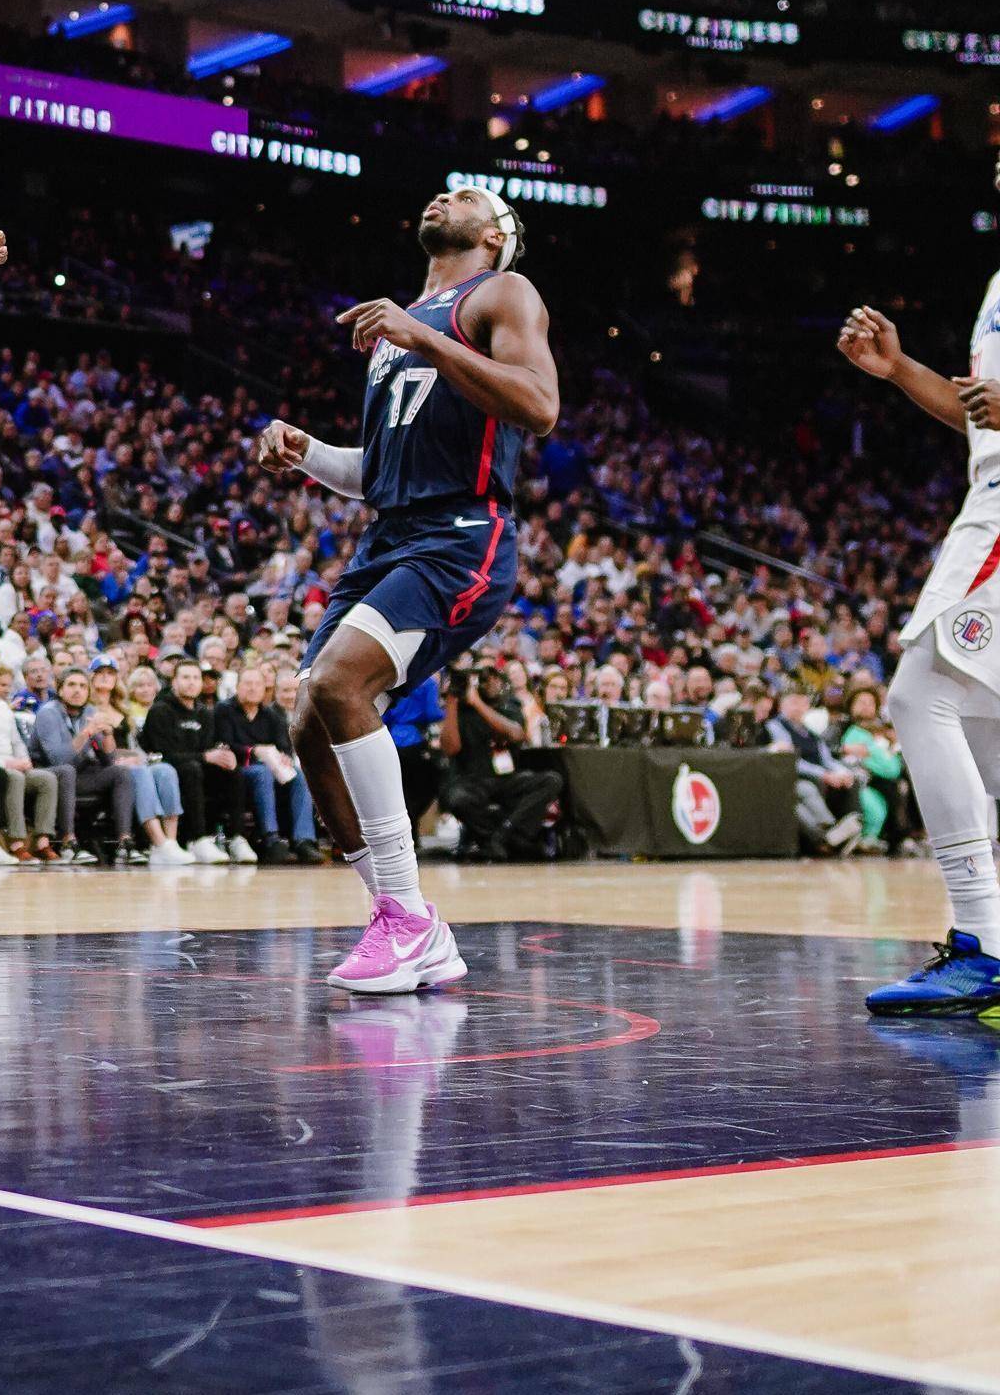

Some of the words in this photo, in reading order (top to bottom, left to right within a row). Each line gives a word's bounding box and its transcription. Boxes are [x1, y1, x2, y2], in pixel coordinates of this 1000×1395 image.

[638, 9, 693, 35] CITY
[9, 94, 111, 133] FITNESS
[211, 130, 264, 159] CITY
[267, 140, 361, 177] FITNESS
[389, 367, 438, 428] 17
